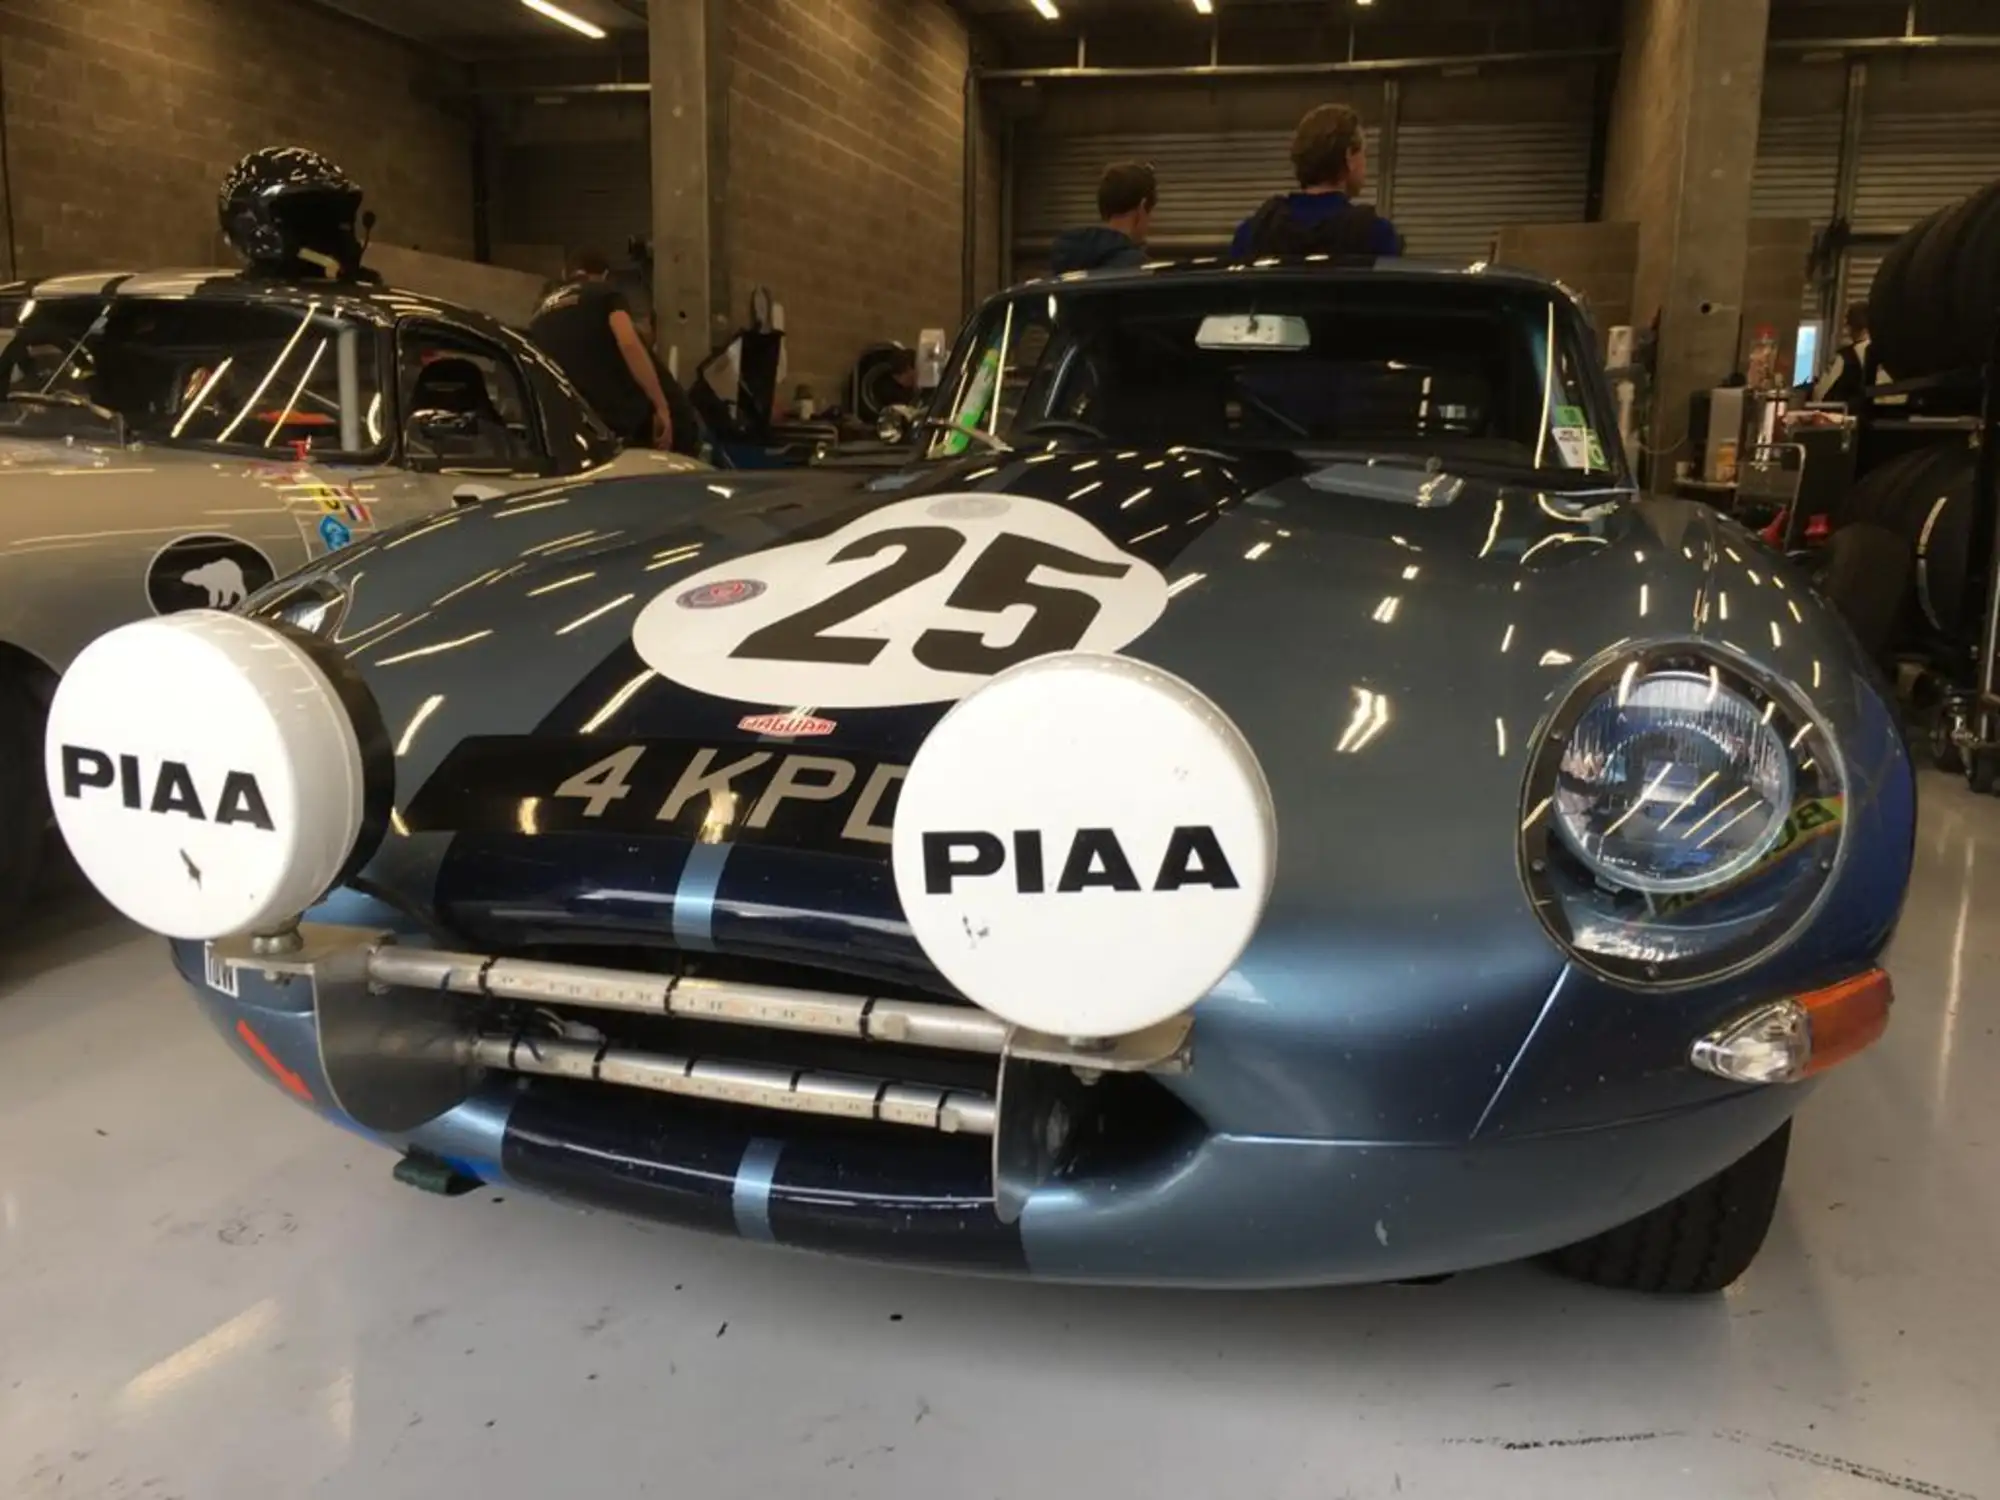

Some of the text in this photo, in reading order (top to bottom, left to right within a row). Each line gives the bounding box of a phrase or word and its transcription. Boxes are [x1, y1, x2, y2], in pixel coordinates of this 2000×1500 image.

[729, 525, 1133, 676] 25
[61, 745, 274, 831] PIAA
[554, 745, 646, 816] 4
[922, 826, 1241, 894] PIAA
